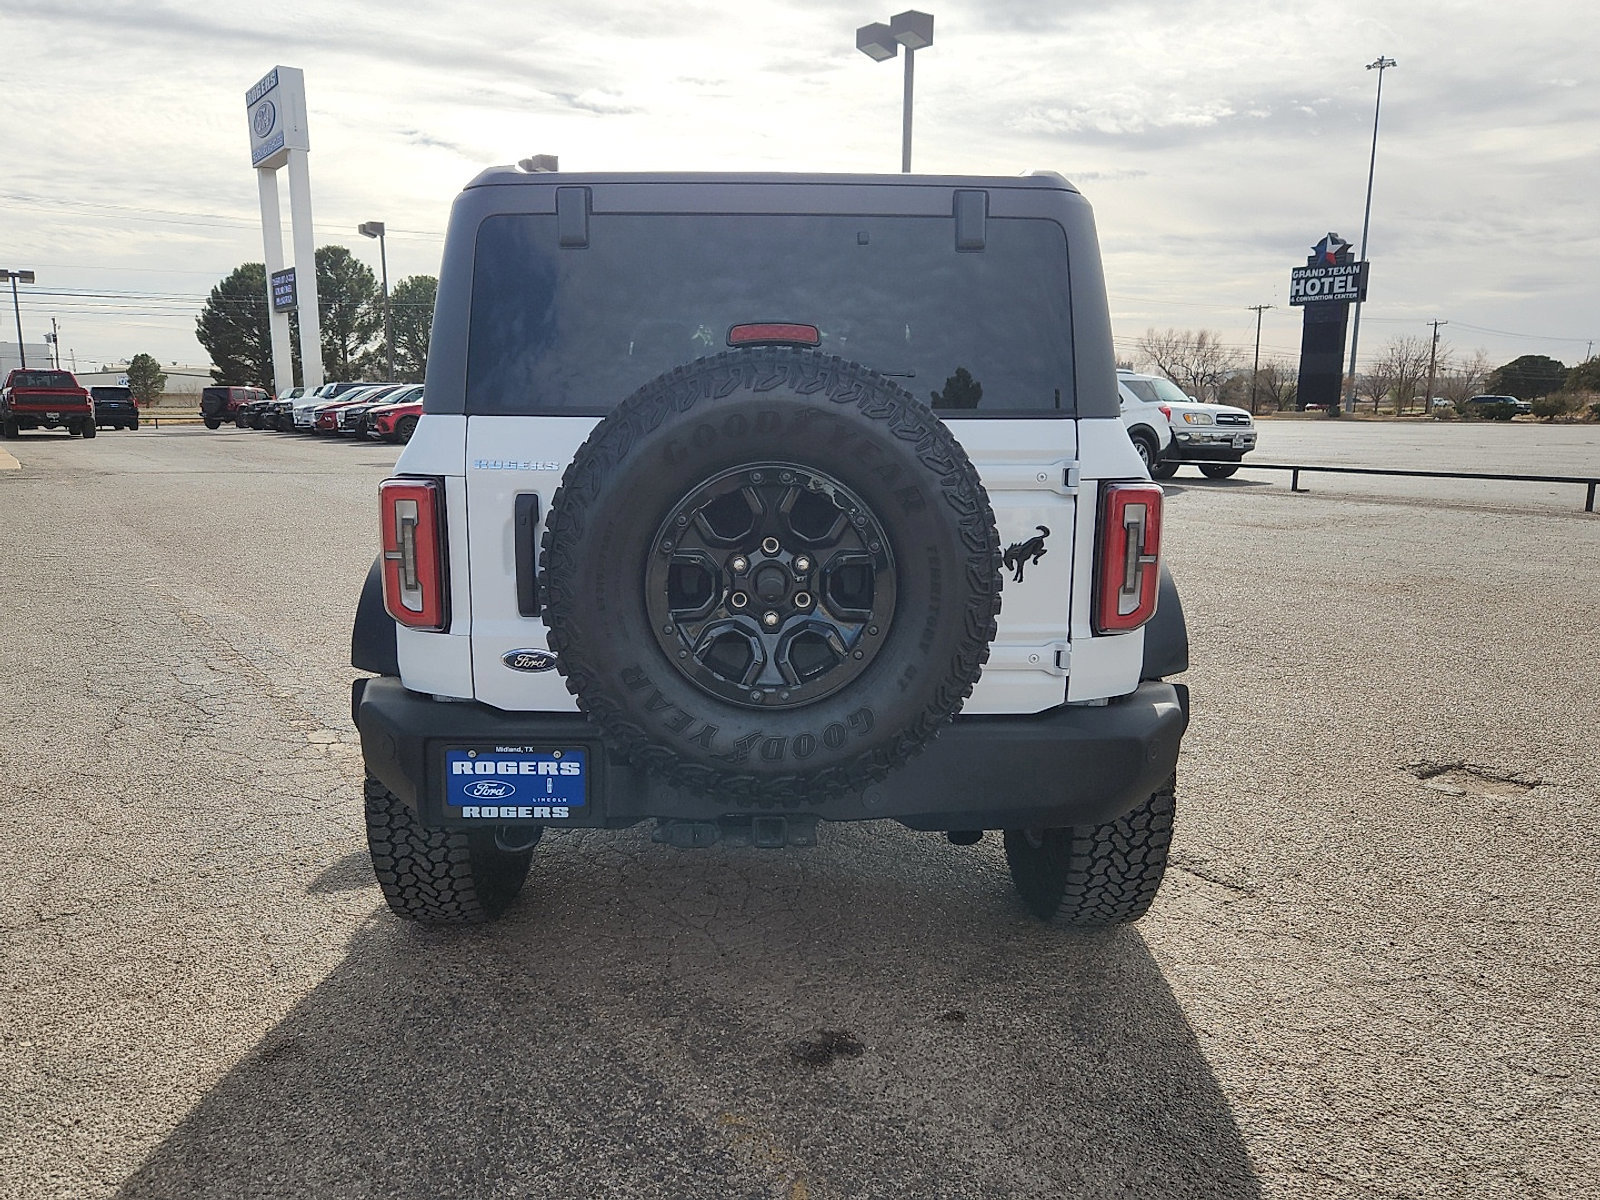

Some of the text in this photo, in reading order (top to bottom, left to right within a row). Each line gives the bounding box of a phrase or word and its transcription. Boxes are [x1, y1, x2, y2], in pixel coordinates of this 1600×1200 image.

[247, 74, 278, 106] ROGERS
[1292, 265, 1360, 279] GRAND TEXAN
[1291, 275, 1358, 296] HOTEL
[1296, 294, 1333, 302] CONVENTION
[474, 459, 560, 471] ROGERS
[514, 654, 547, 668] Ford
[495, 746, 524, 754] Midland,
[452, 761, 580, 776] ROGERS
[473, 783, 505, 796] Ford
[462, 806, 569, 818] ROGERS
